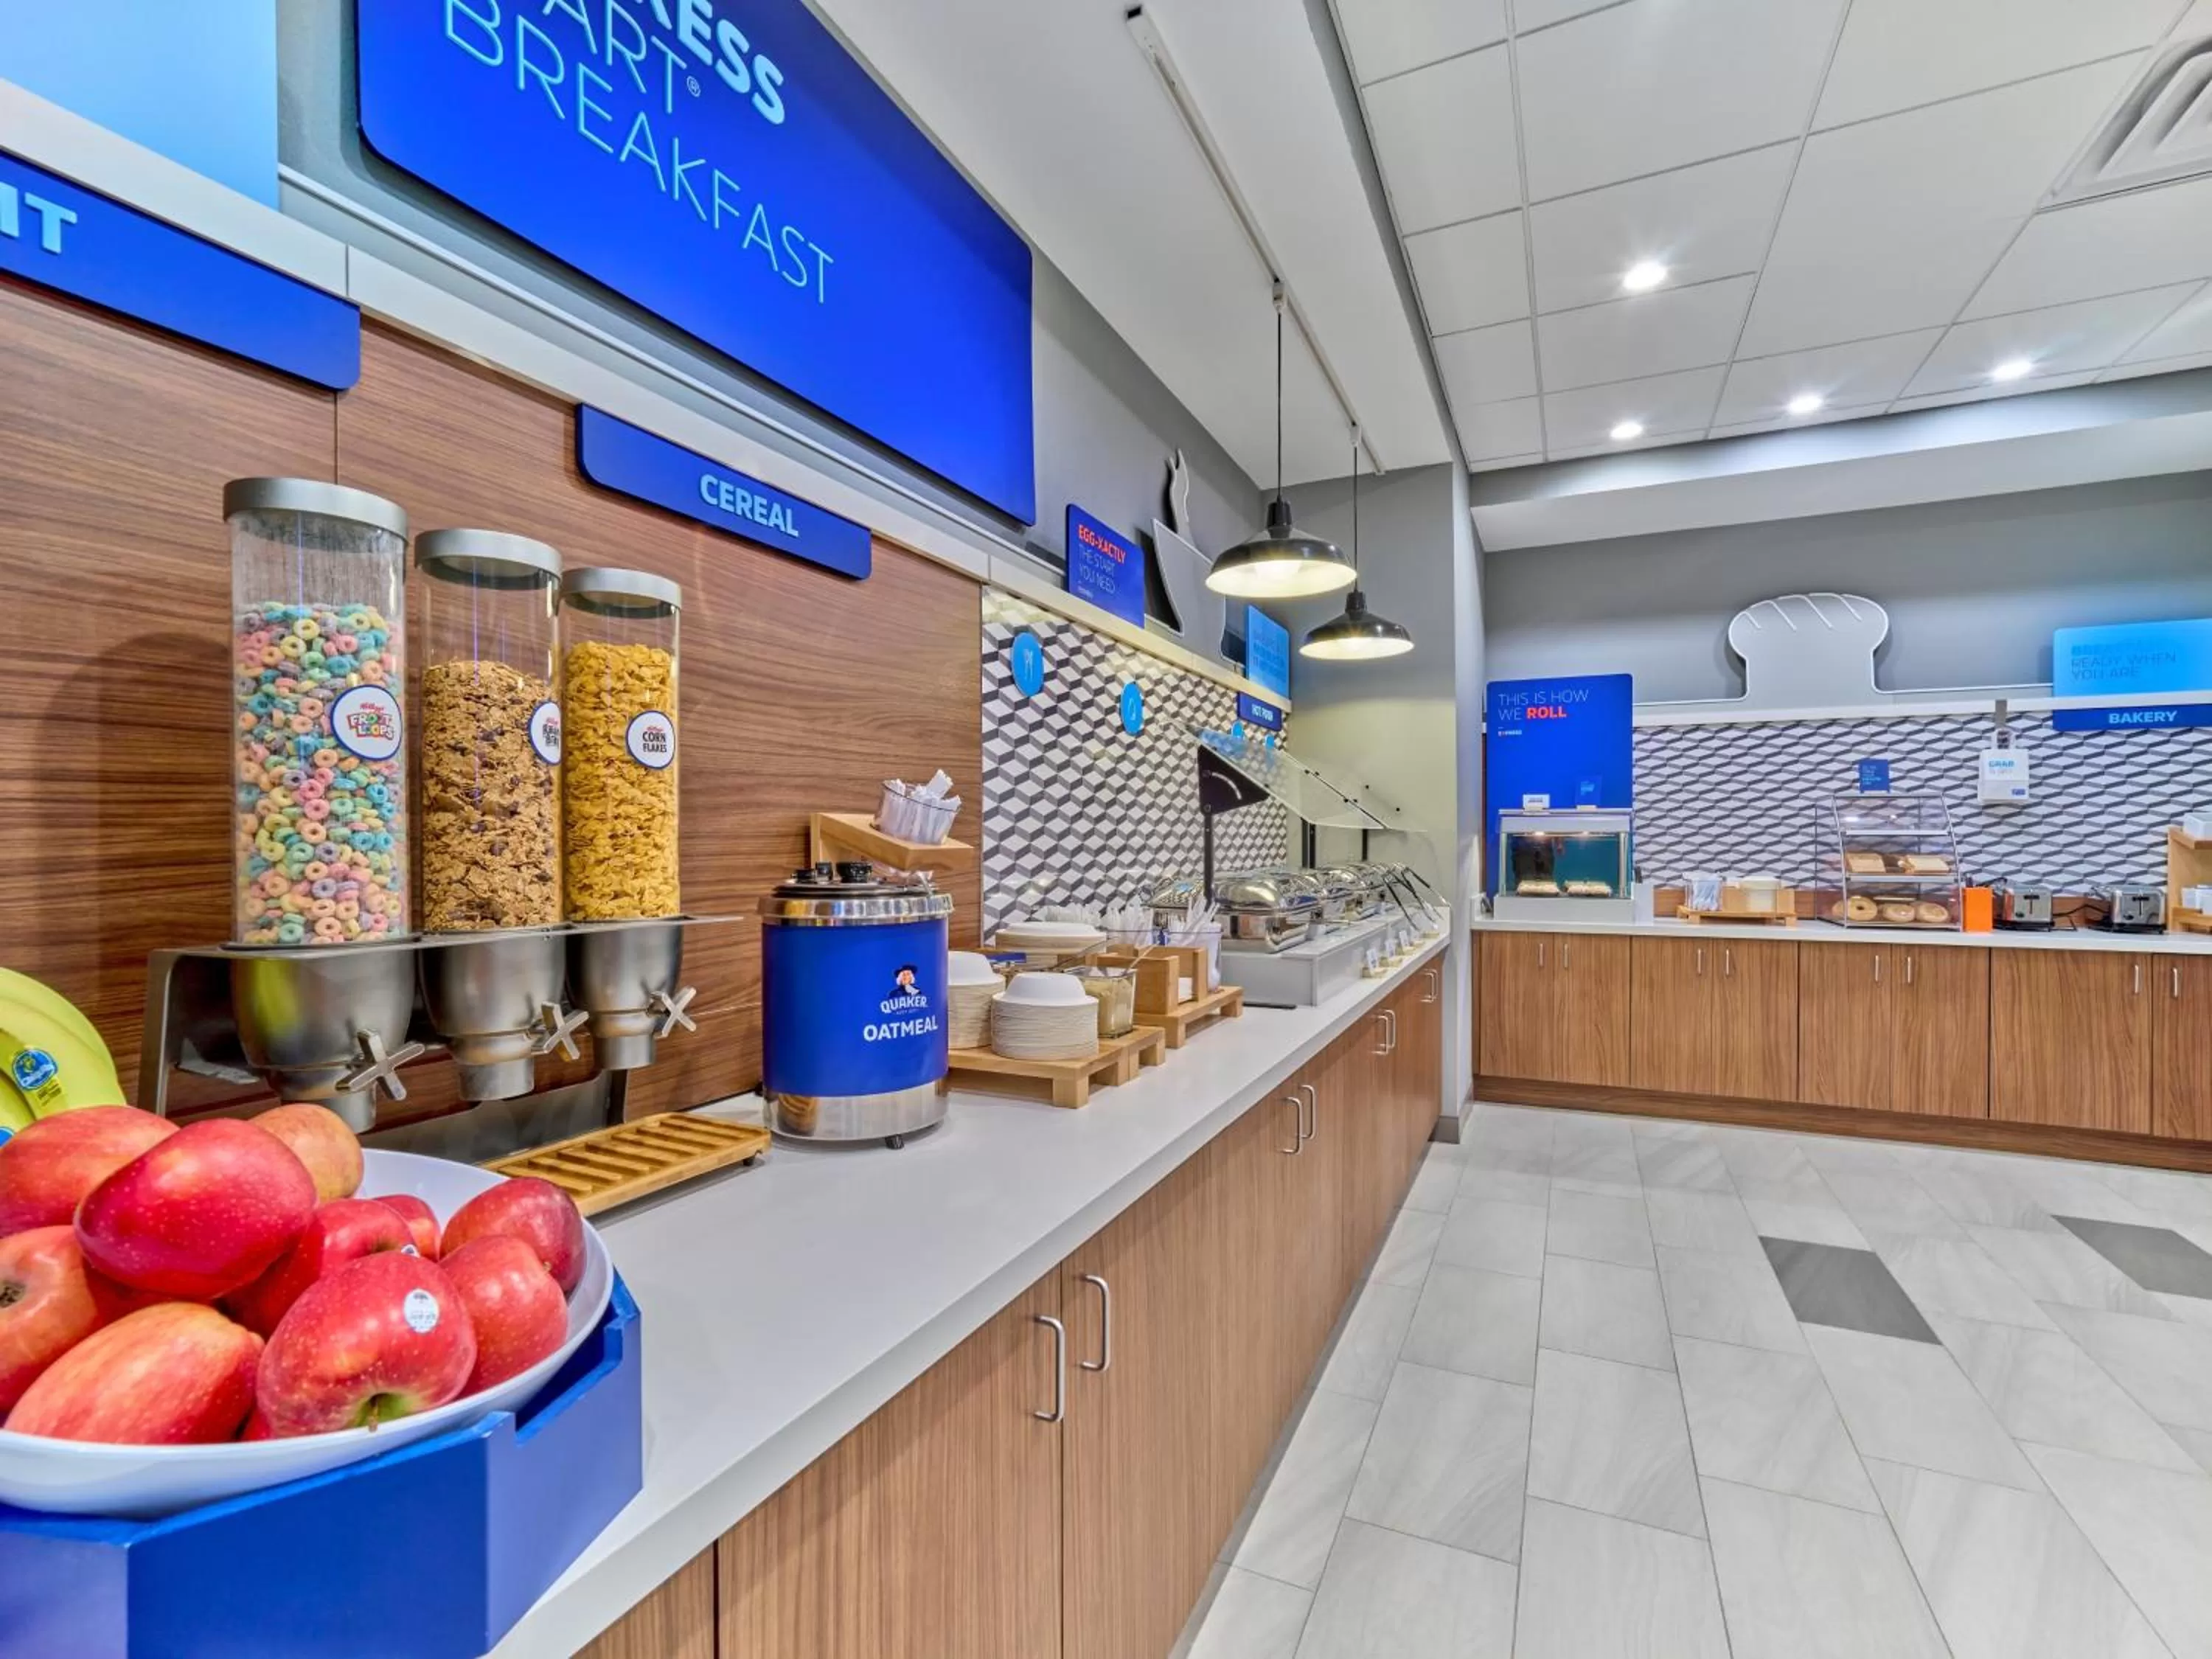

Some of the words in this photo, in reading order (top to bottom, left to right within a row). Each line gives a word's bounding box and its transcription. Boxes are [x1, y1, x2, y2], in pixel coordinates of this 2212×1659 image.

[444, 0, 834, 303] BREAKFAST
[700, 473, 799, 538] CEREAL
[1078, 524, 1126, 564] EGG-XACTLY
[1498, 692, 1528, 706] THIS
[1534, 690, 1546, 704] IS
[1551, 689, 1589, 703] HOW
[1498, 707, 1523, 720] WE
[1526, 706, 1567, 720] ROLL
[2109, 711, 2177, 724] BAKERY
[642, 731, 666, 742] CORN
[880, 996, 928, 1014] QUAKER
[863, 1015, 939, 1043] OATMEAL
